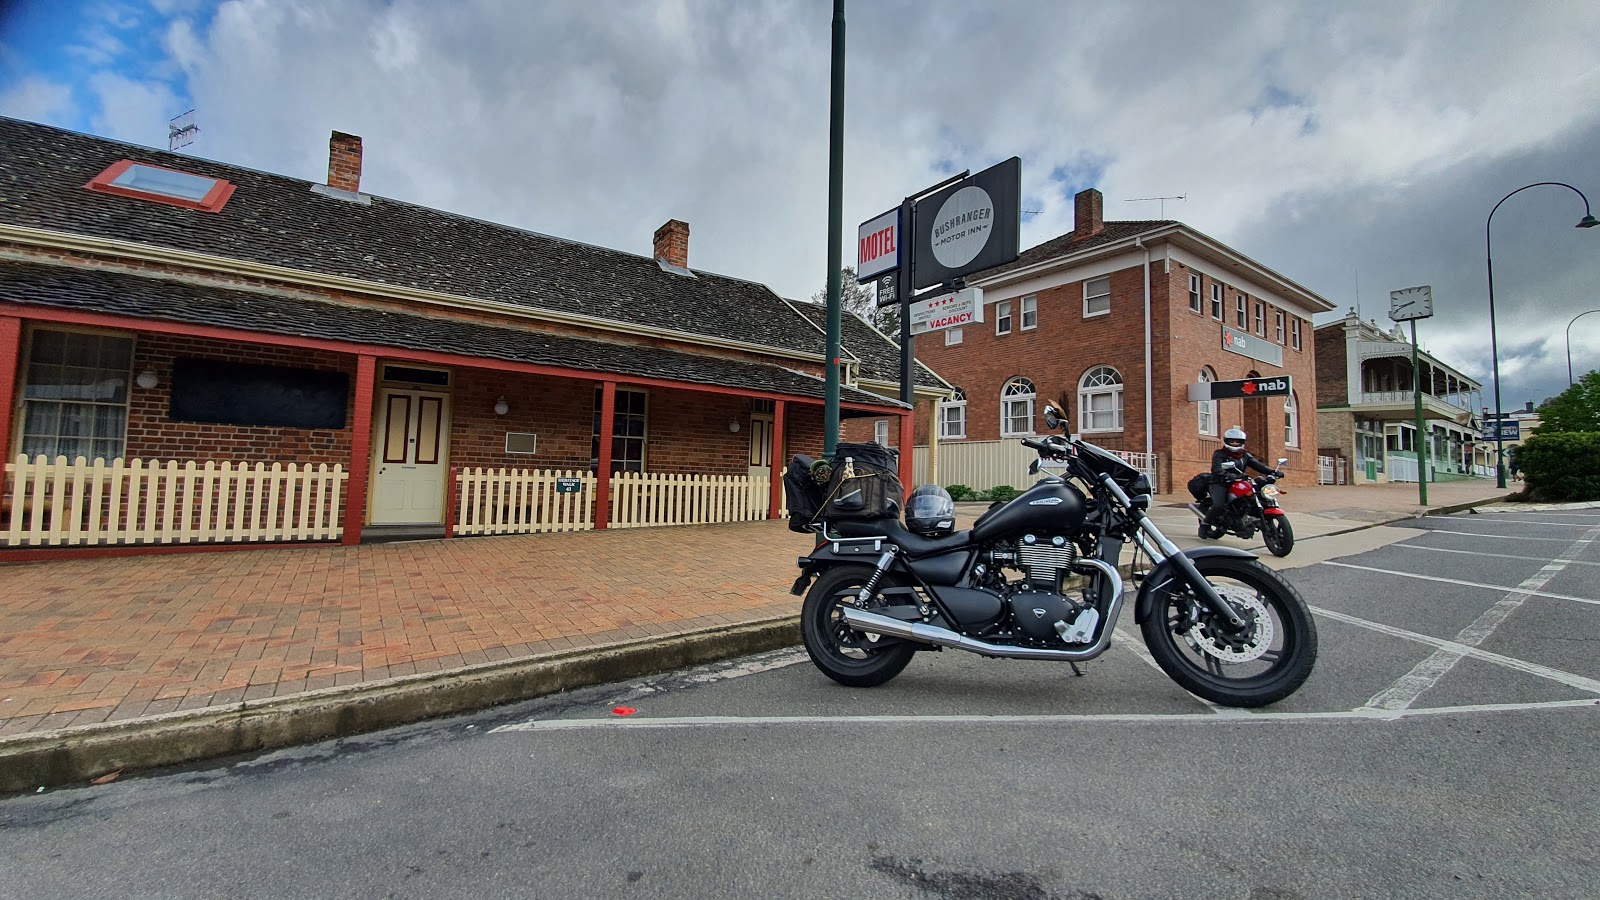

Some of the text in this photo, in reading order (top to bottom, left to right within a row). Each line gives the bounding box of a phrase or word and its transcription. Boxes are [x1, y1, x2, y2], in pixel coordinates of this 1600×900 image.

[934, 207, 991, 239] BUSHRANGER
[940, 224, 982, 246] MOTOR INN
[860, 225, 896, 264] MOTEL
[879, 294, 895, 302] WI-FI
[880, 286, 895, 296] FREE
[929, 312, 973, 329] VACANCY
[1233, 336, 1246, 348] nab
[1258, 380, 1287, 391] nab
